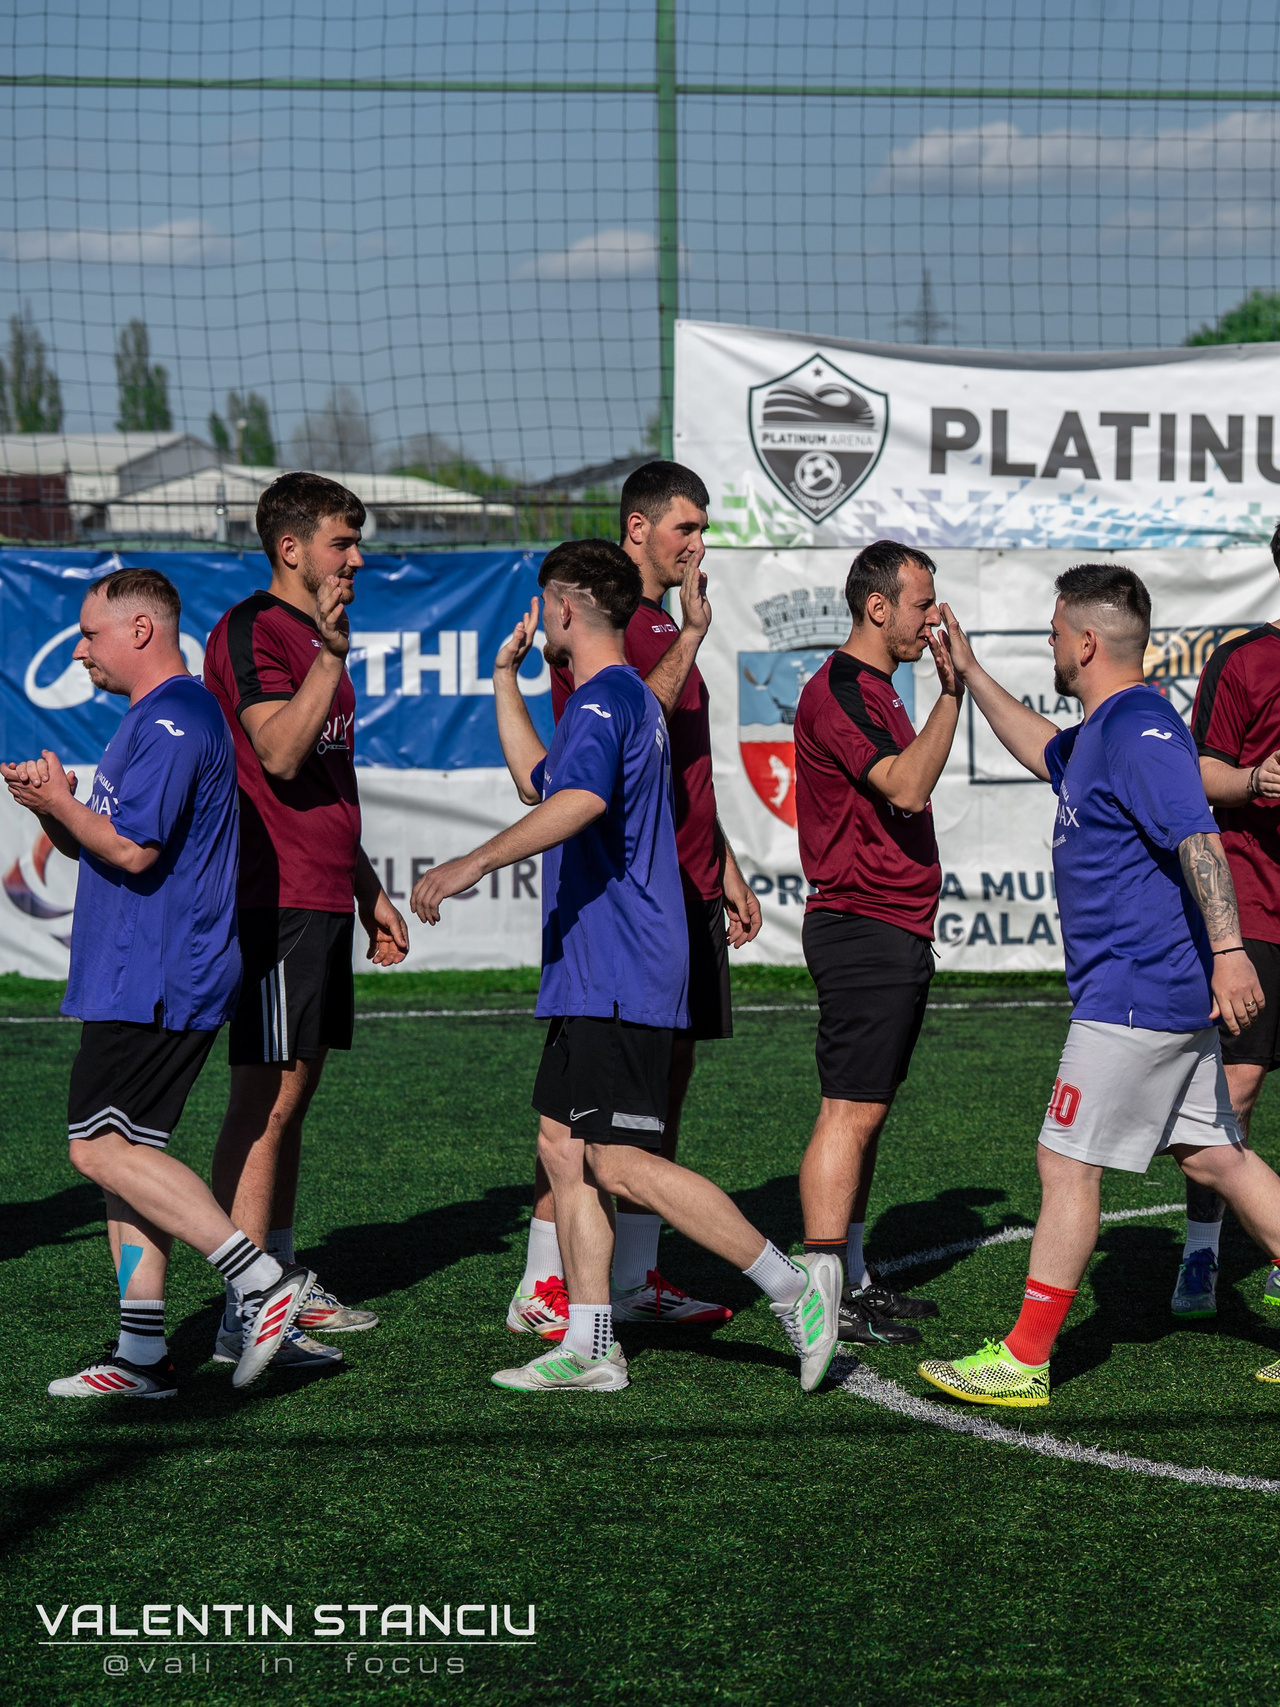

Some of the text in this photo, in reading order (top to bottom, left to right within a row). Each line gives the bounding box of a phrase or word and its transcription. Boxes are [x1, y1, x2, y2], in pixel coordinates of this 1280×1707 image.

[762, 432, 874, 446] PLATINUM ARENA
[939, 912, 1062, 946] GALA
